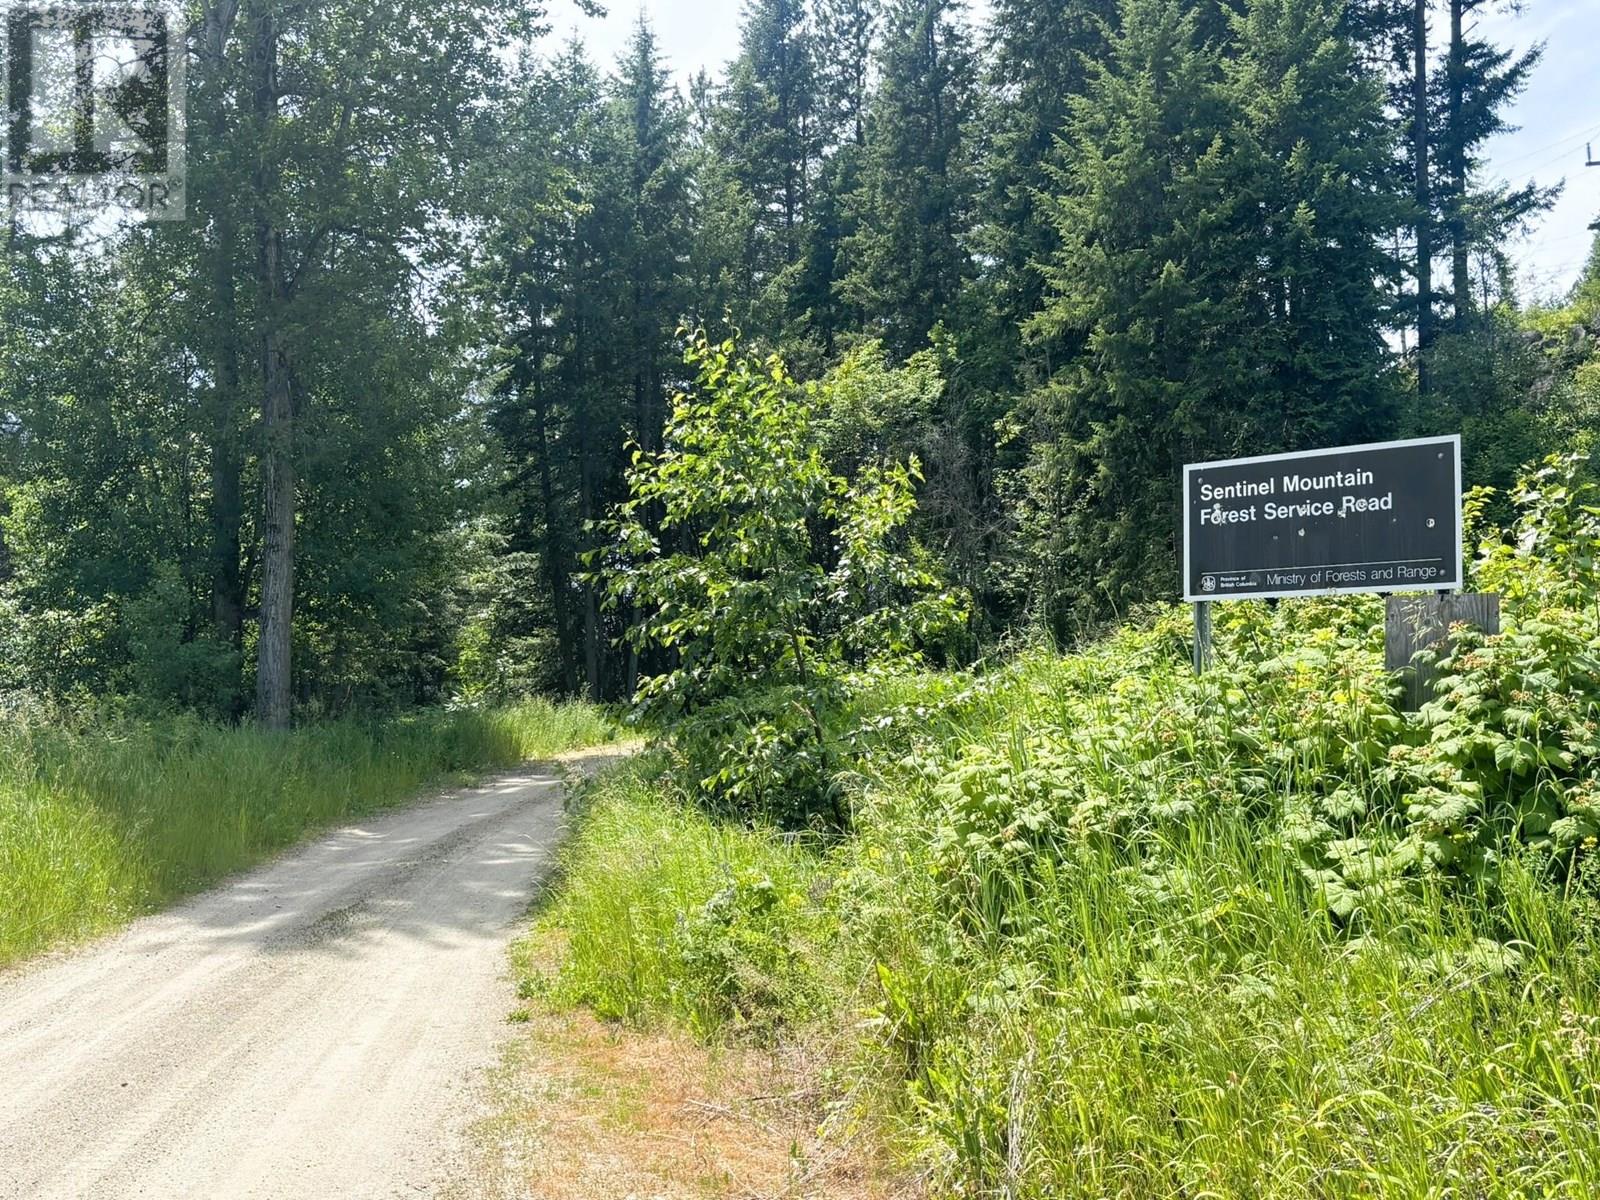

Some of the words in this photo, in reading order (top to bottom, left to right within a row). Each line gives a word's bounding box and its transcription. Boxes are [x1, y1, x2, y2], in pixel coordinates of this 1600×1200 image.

[1200, 478, 1274, 501] Sentinel
[1283, 469, 1373, 493] Mountain
[1200, 505, 1256, 525] Forest
[1264, 500, 1334, 520] Service
[1342, 492, 1392, 513] Road
[1266, 572, 1306, 586] Ministry
[1310, 571, 1321, 583] of
[1325, 569, 1367, 582] Forests
[1371, 567, 1393, 580] and
[1397, 565, 1437, 579] Range
